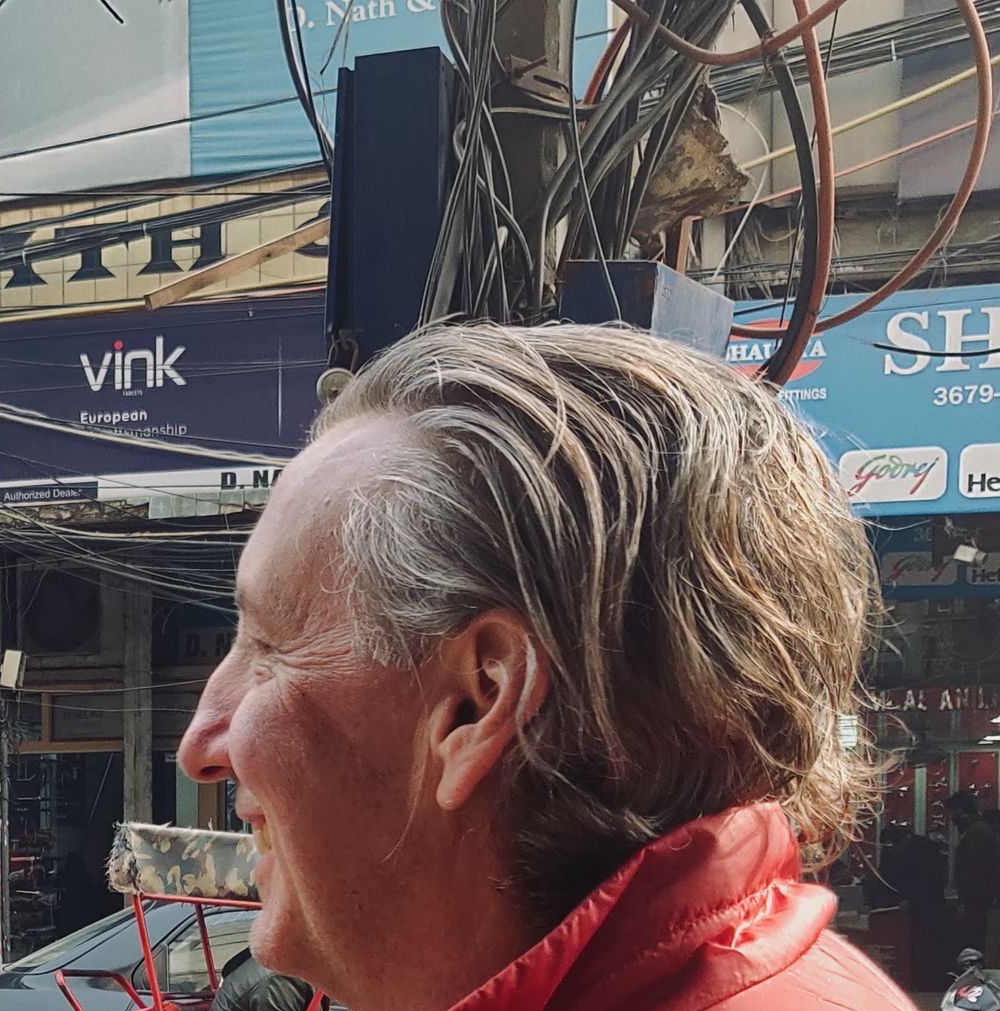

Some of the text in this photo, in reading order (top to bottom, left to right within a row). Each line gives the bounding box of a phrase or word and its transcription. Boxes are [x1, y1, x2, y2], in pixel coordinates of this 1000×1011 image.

[325, 0, 397, 27] Nath
[80, 335, 187, 391] vink
[80, 410, 148, 425] European
[220, 472, 245, 491] D.
[846, 453, 941, 497] Godrej
[3, 489, 51, 501] Authorized
